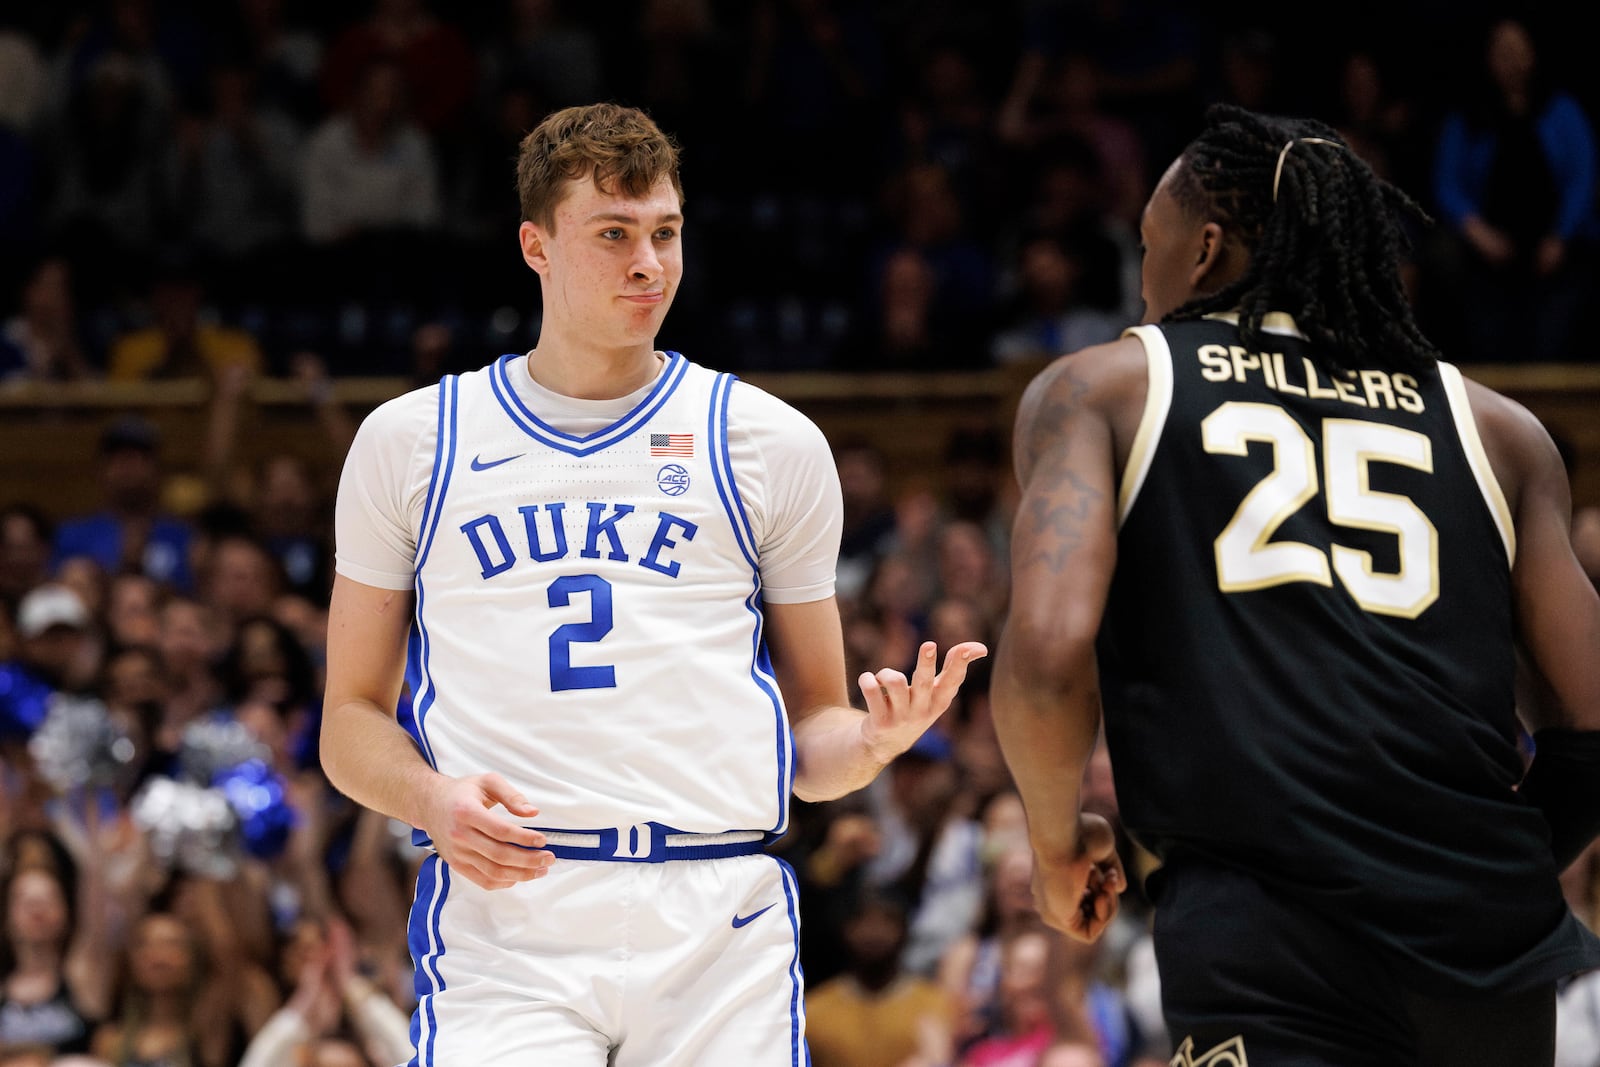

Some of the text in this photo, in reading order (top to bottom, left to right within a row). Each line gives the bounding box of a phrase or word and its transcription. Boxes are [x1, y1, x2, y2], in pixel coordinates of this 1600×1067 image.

[1197, 344, 1426, 415] SPILLERS
[661, 474, 688, 483] ACC
[1200, 400, 1440, 620] 25
[459, 502, 699, 580] DUKE
[547, 574, 617, 692] 2
